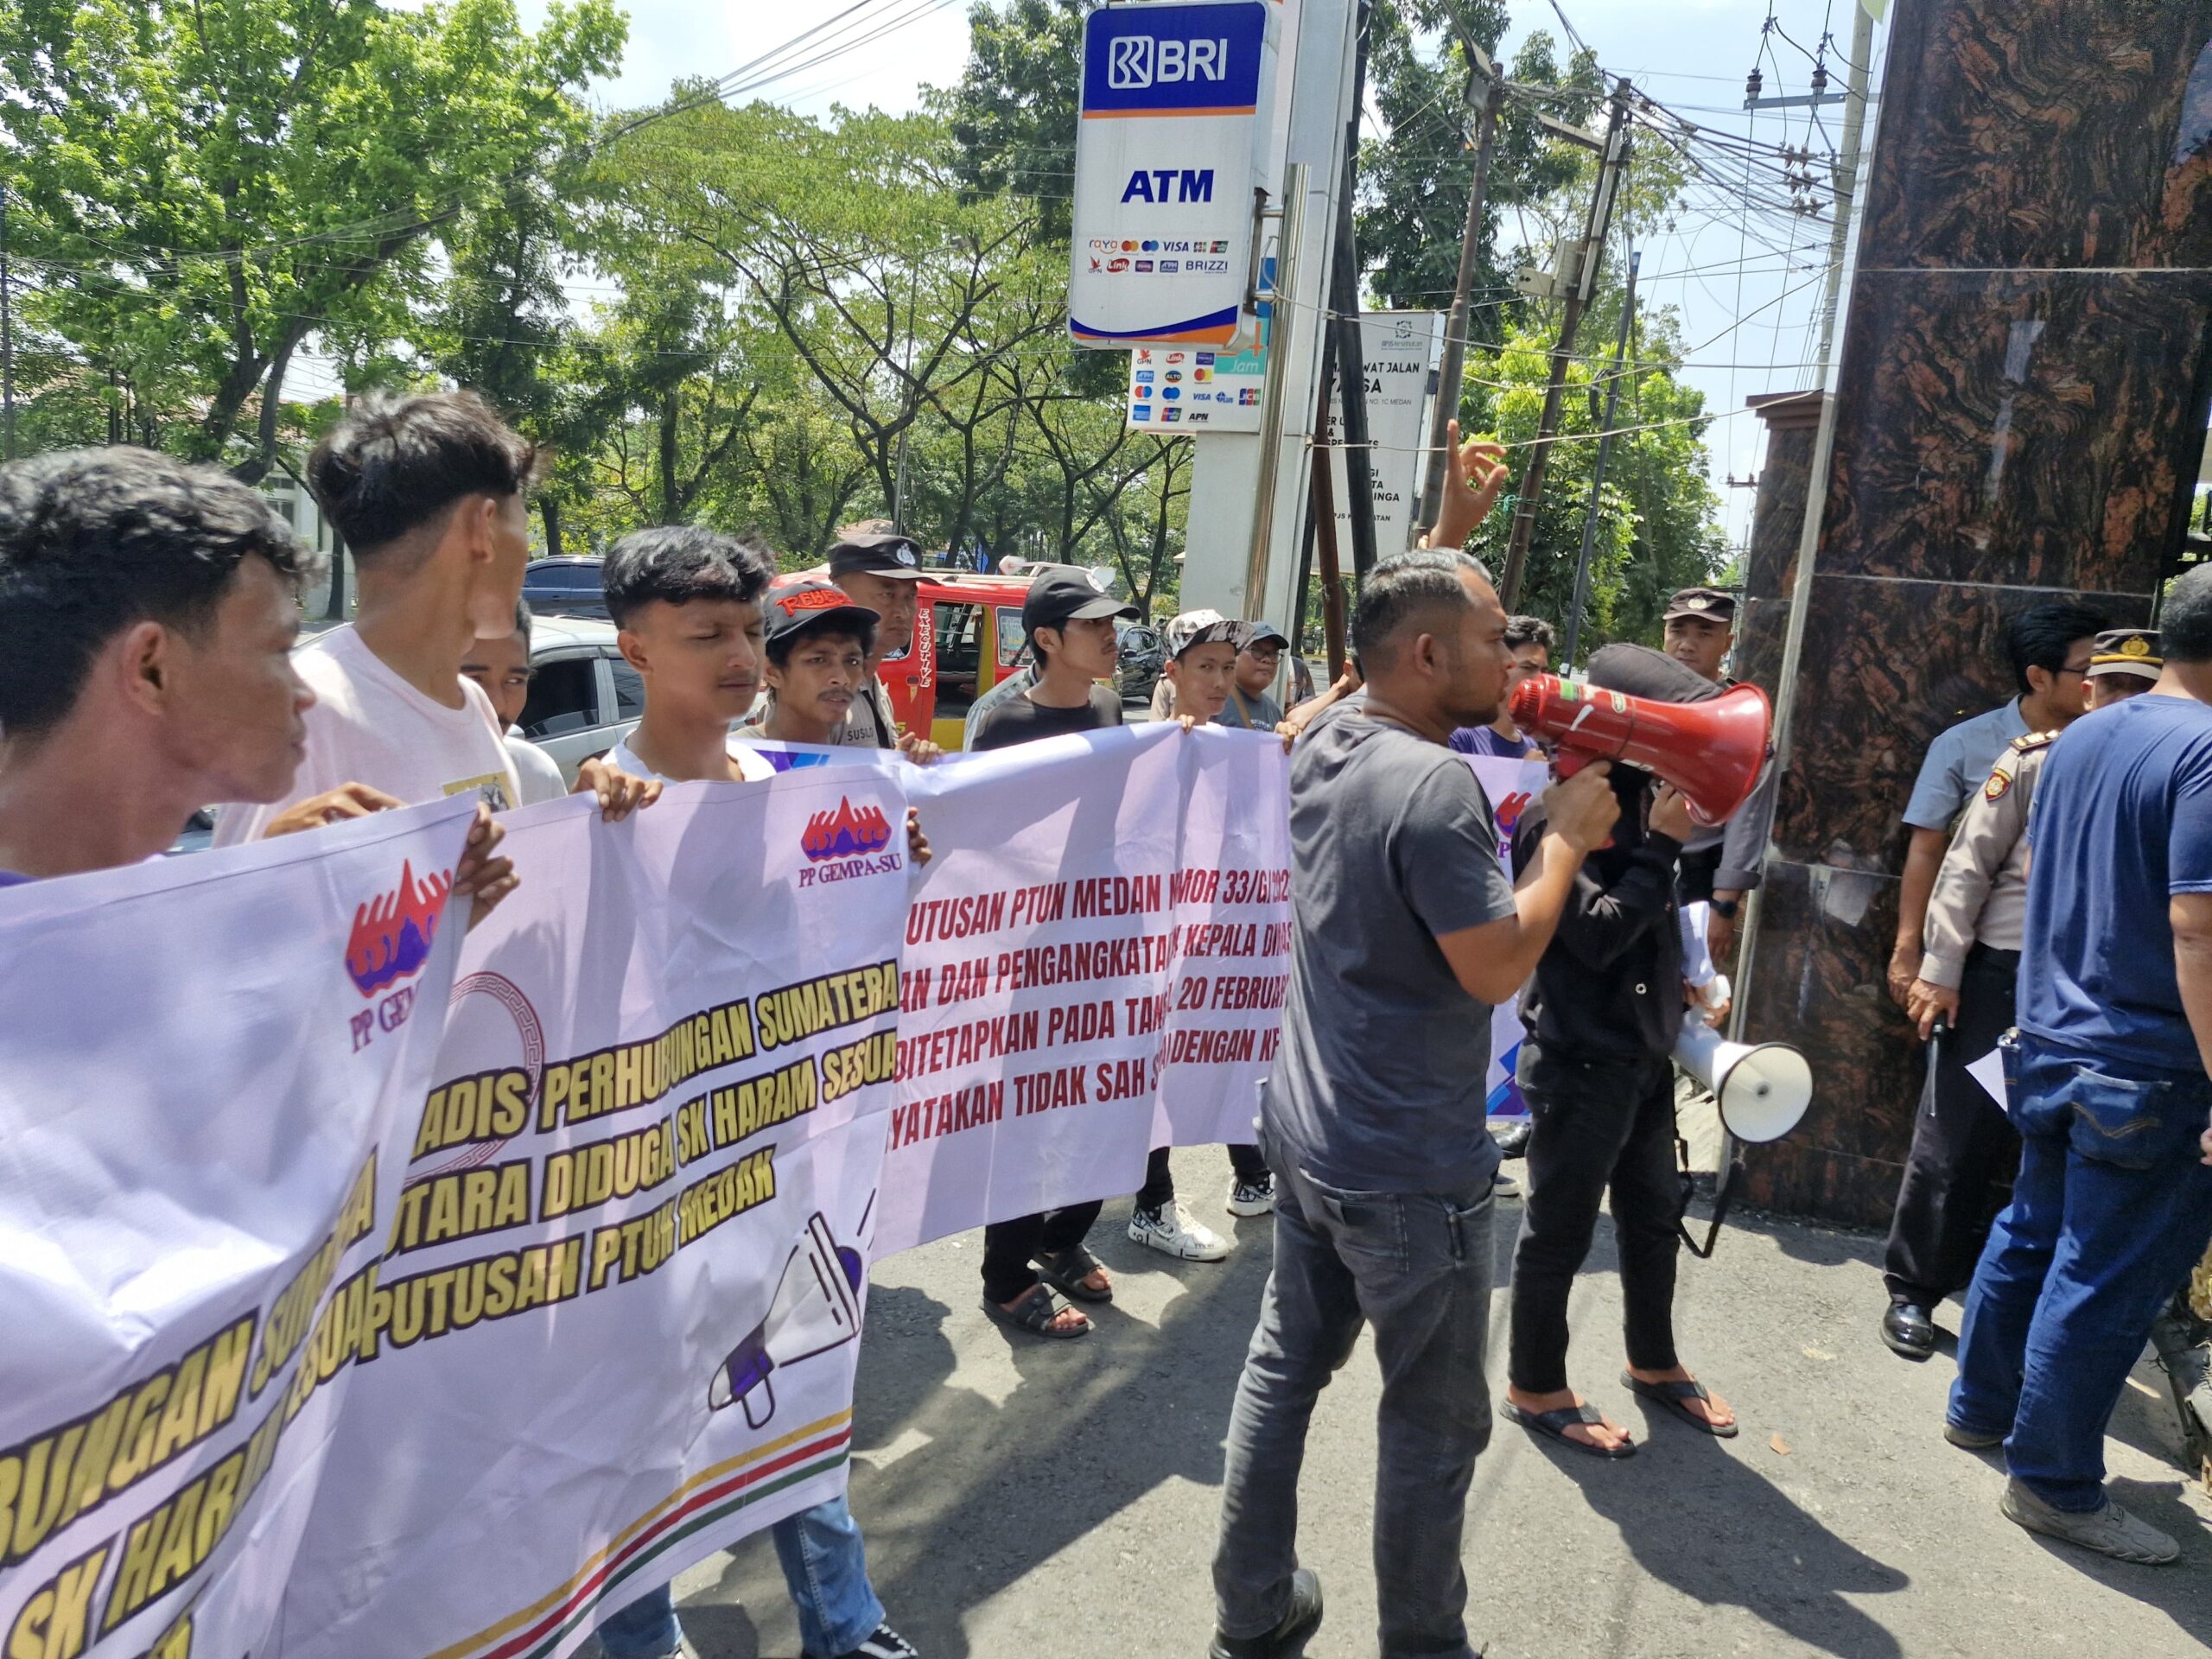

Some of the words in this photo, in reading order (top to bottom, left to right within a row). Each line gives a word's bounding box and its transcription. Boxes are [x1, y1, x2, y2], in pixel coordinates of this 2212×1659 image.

[1157, 38, 1228, 82] BRI
[1121, 169, 1214, 203] ATM
[1108, 259, 1128, 272] Link
[1186, 260, 1228, 270] BRIZZI
[1162, 241, 1190, 252] VISA
[1166, 353, 1183, 362] Link
[1231, 359, 1259, 372] Jam
[1386, 362, 1420, 373] JALAN
[918, 607, 932, 688] EXECUTIVE
[798, 867, 817, 887] PP
[819, 855, 903, 885] GEMPA-SU
[1009, 881, 1067, 929] PTUN
[1071, 874, 1161, 918] MEDAN
[937, 956, 989, 1007] DAN
[1182, 924, 1257, 957] KEPALA
[536, 997, 756, 1135] PERHUBUNGAN
[754, 958, 899, 1052] SUMATERA
[893, 1009, 1038, 1084] DITETAPKAN
[1046, 999, 1116, 1047] PADA
[1176, 976, 1209, 1010] 20
[1014, 1064, 1087, 1117] TIDAK
[1096, 1057, 1145, 1099] SAH
[1170, 1028, 1256, 1065] DENGAN
[538, 1112, 674, 1223] DIDUGA
[673, 1097, 709, 1169] SK
[711, 1058, 818, 1149] HARAM
[586, 1196, 677, 1295] PTUN
[677, 1144, 776, 1249] MEDAN
